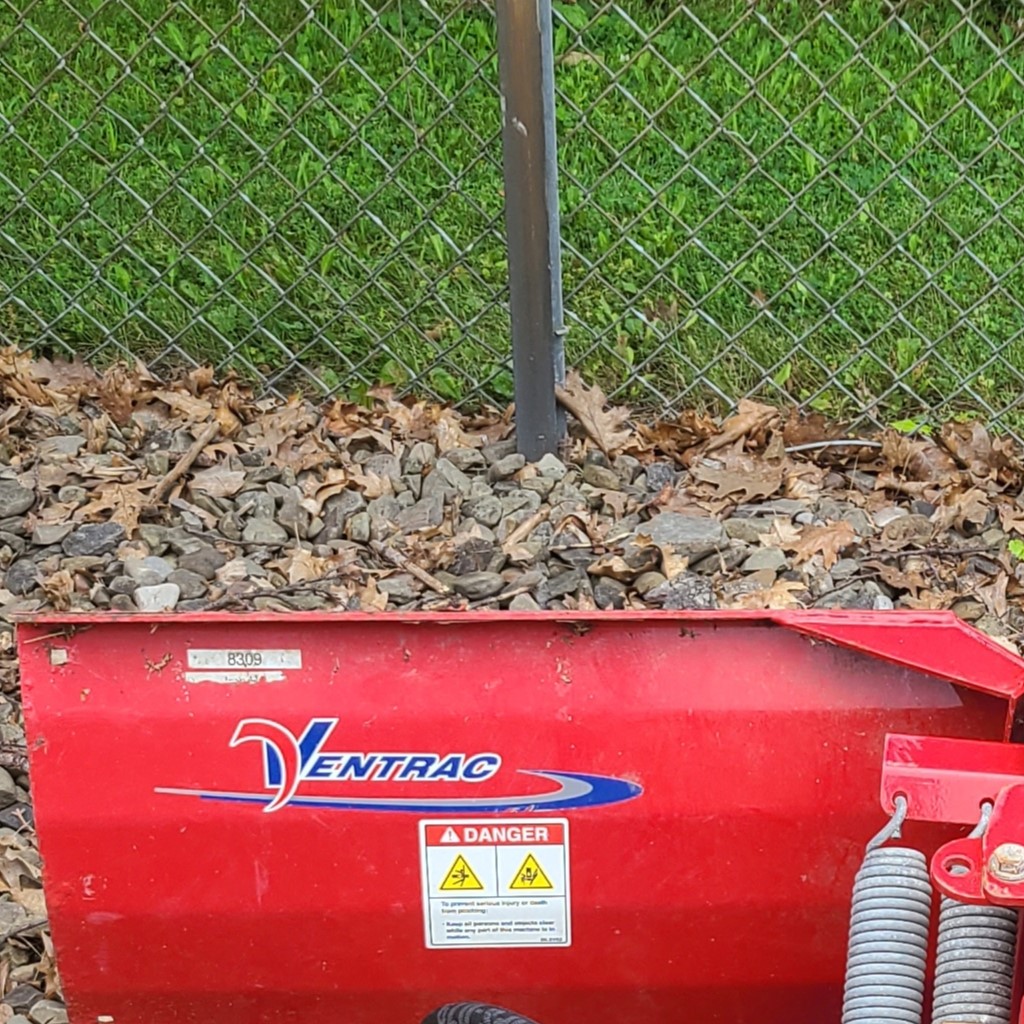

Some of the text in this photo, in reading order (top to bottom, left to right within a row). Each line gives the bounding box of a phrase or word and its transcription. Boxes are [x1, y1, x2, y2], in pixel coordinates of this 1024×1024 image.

[227, 652, 262, 666] 8309
[229, 718, 501, 812] VENTRAC
[463, 826, 548, 842] DANGER
